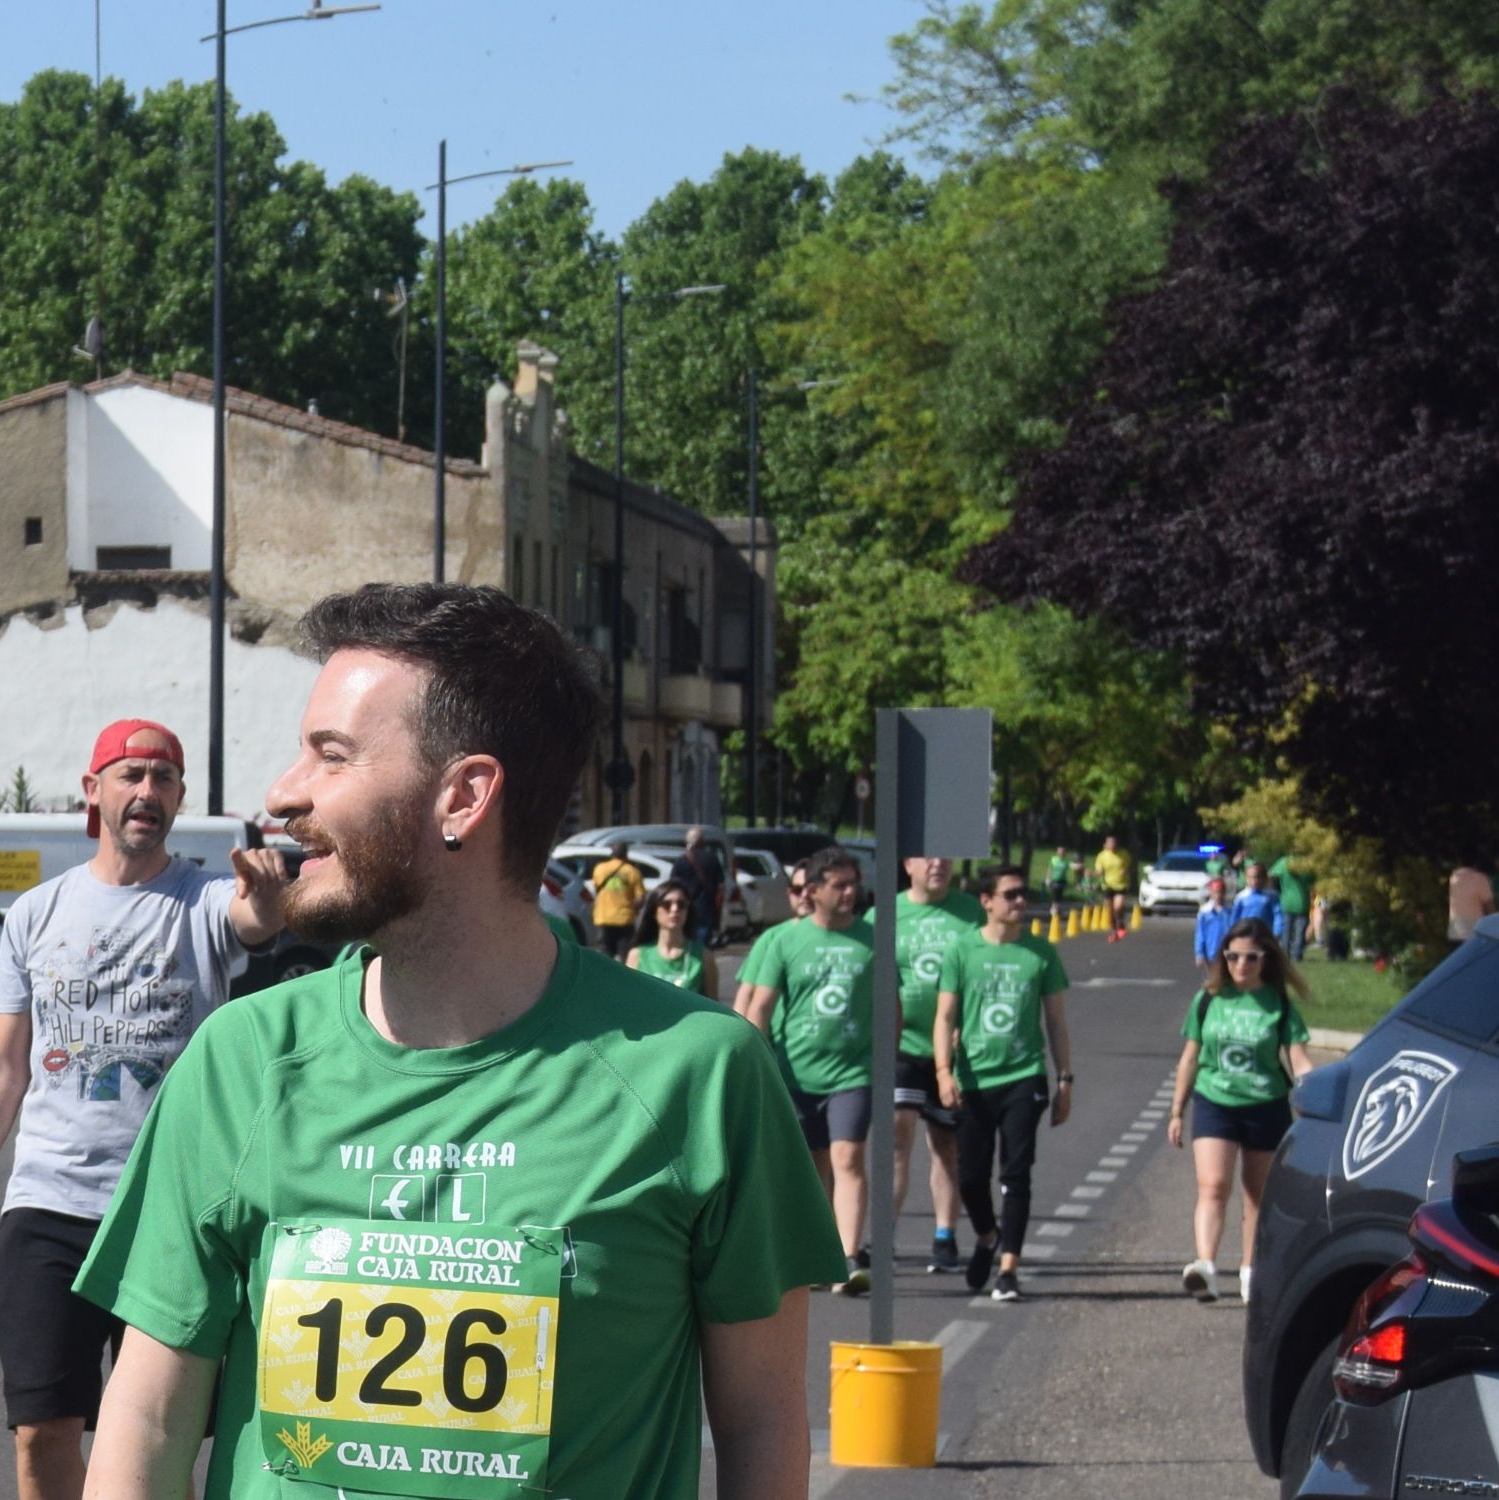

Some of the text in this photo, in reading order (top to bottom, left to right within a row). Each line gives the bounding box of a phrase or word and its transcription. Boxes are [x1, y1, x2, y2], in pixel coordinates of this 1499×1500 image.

[54, 979, 99, 1012] RED
[93, 1015, 168, 1048] PEPPERS
[340, 1142, 515, 1170] VII CARRERA
[359, 1231, 522, 1261] FUNDACION
[356, 1255, 520, 1286] CAJA RURAL
[298, 1297, 509, 1412] 126
[336, 1441, 528, 1479] CAJA RURAL
